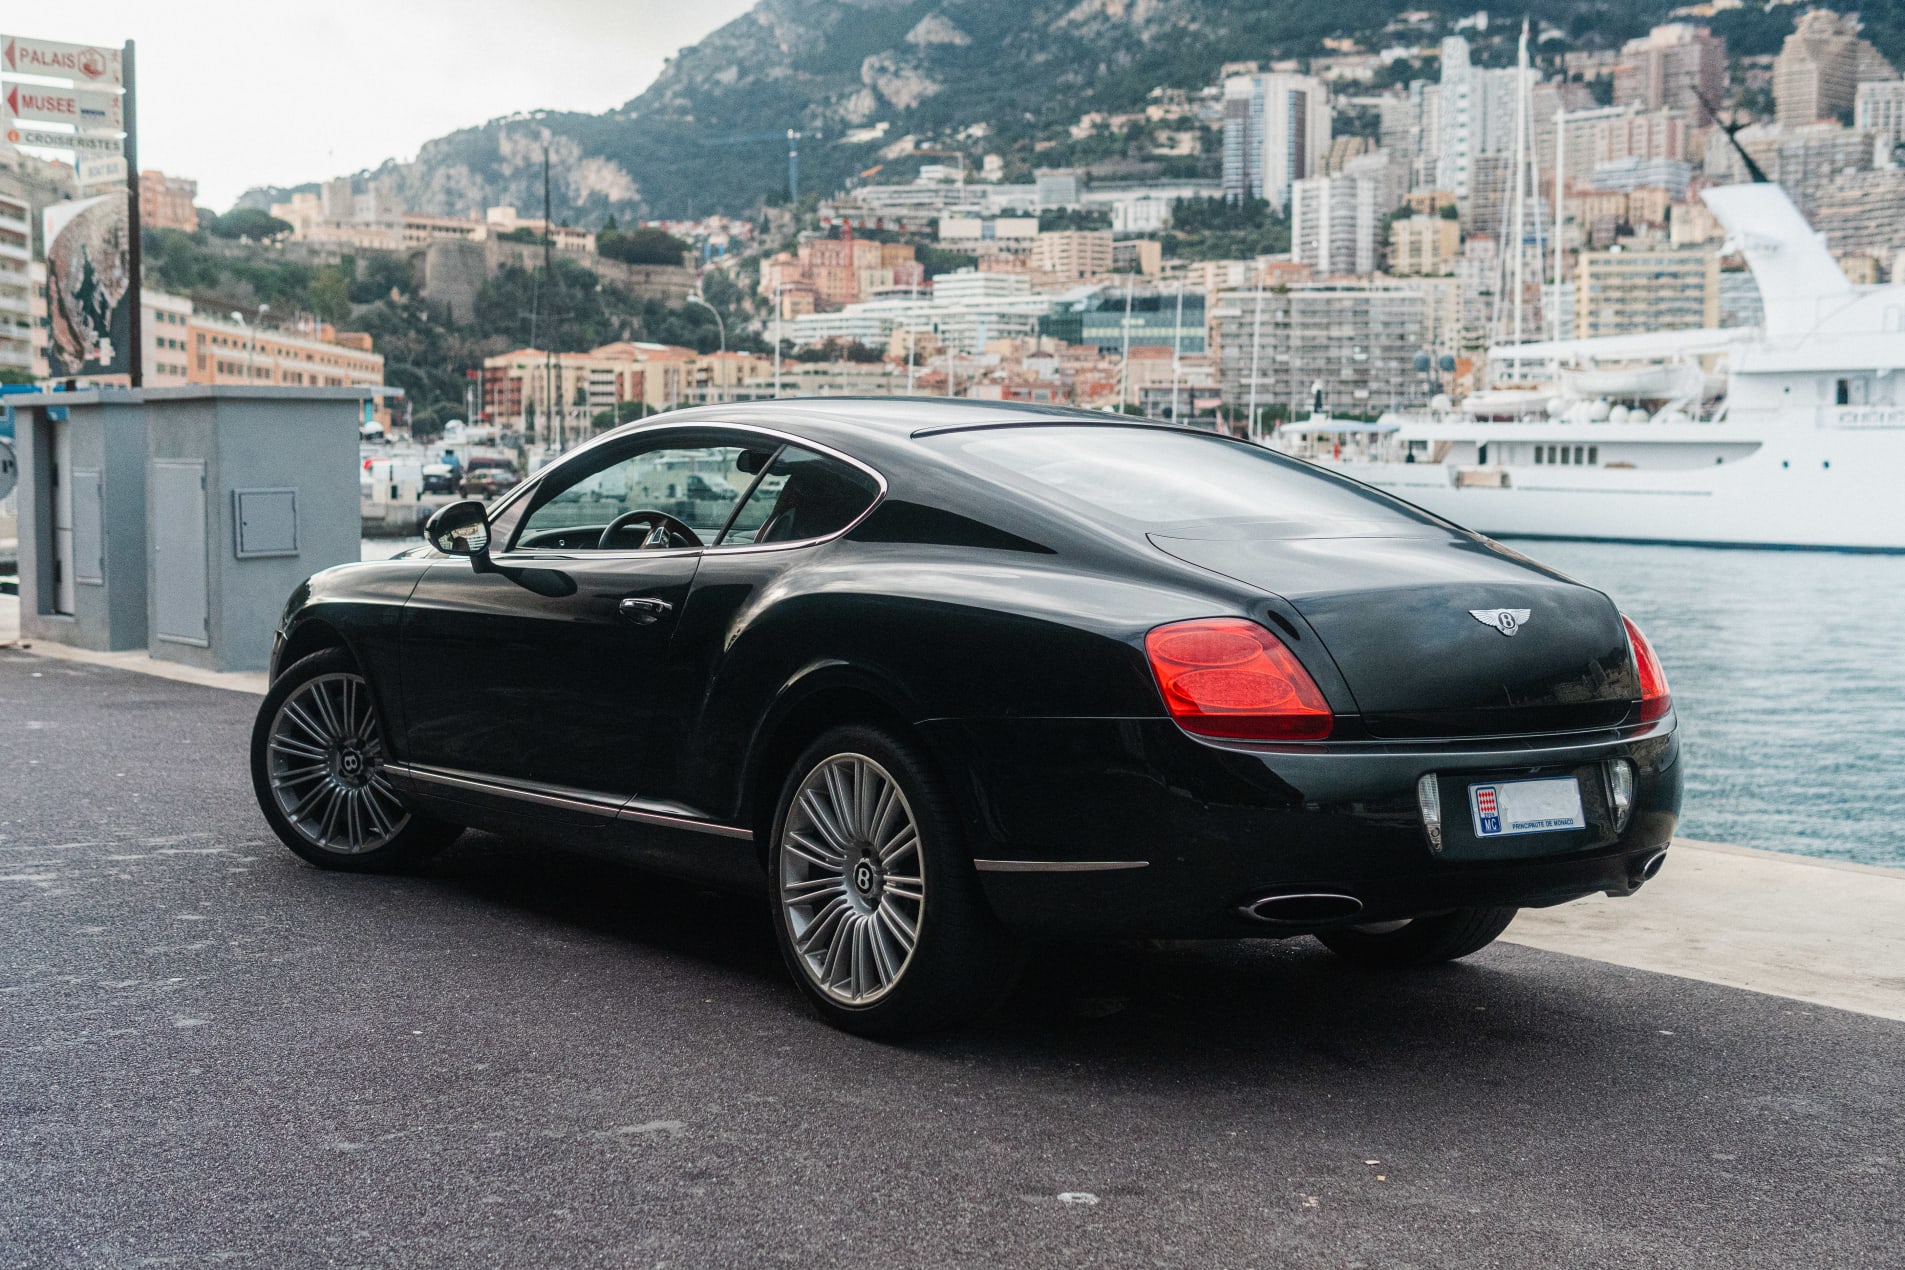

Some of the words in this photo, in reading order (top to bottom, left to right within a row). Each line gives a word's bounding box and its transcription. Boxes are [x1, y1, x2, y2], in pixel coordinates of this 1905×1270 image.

[19, 47, 76, 69] PALAIS
[25, 132, 120, 151] CROISIERISTES
[1485, 818, 1497, 830] MC
[1554, 818, 1574, 826] MONACO
